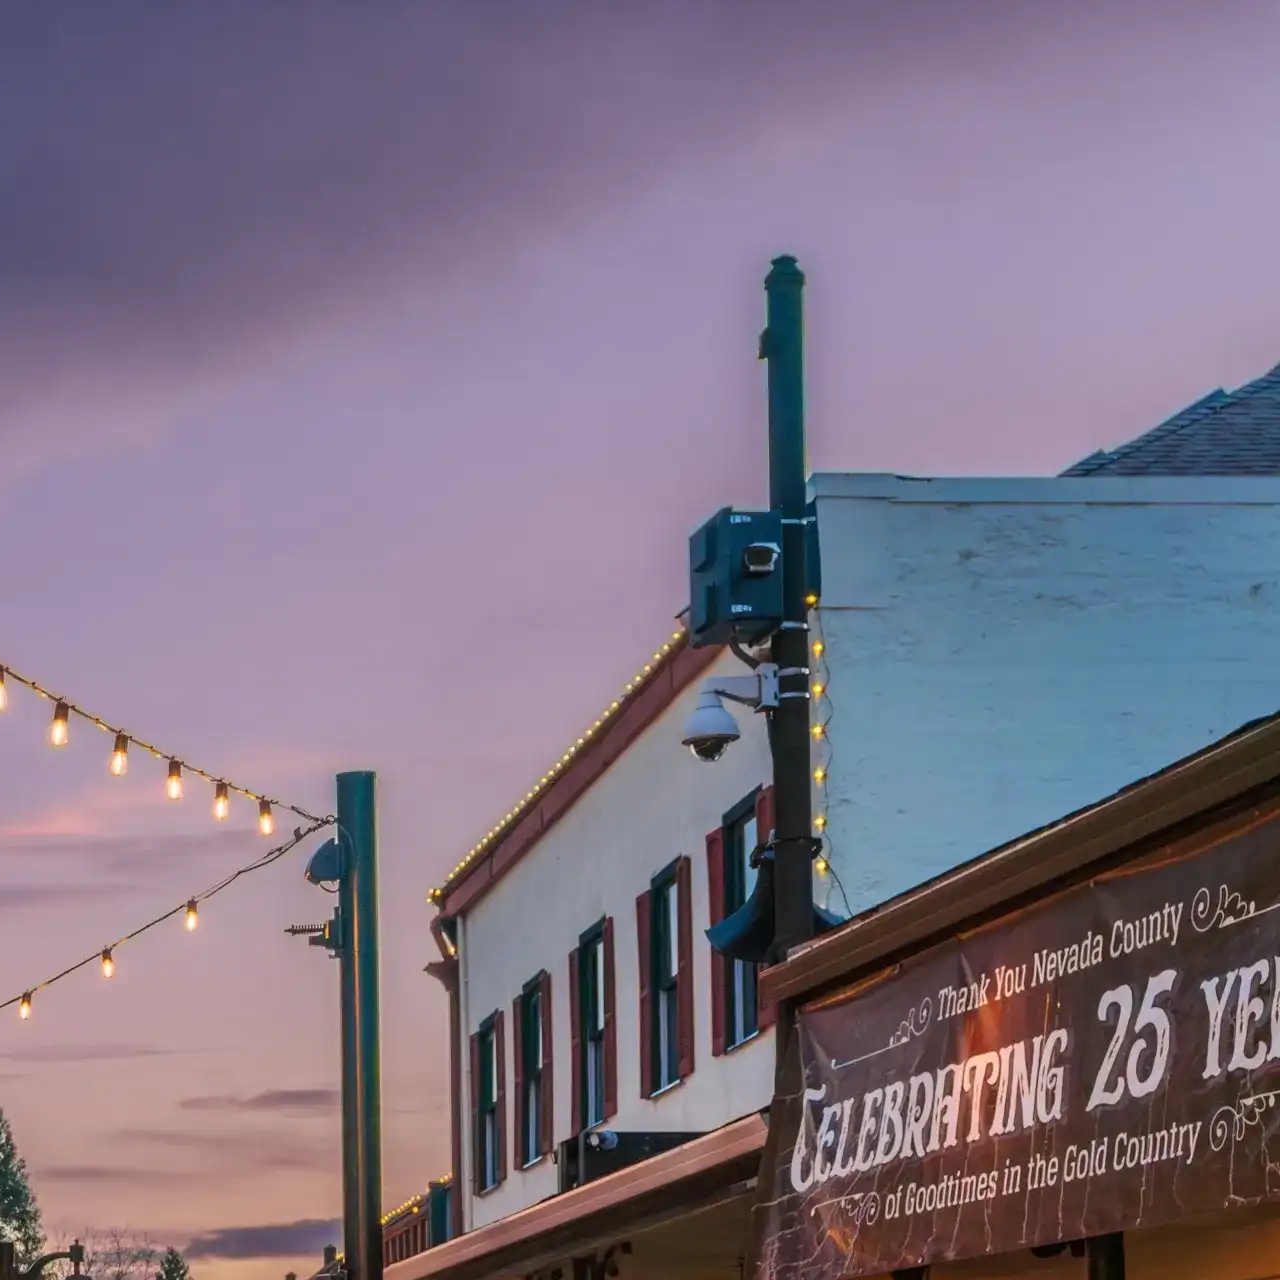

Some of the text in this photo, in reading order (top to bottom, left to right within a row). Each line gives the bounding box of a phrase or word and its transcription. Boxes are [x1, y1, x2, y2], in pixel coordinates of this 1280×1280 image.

[936, 902, 1184, 1022] Thank You Nevada County
[790, 1028, 1069, 1193] CELEBRATING
[1085, 968, 1178, 1112] 25
[884, 1119, 1203, 1220] of Goodtimes in the Gold Country
